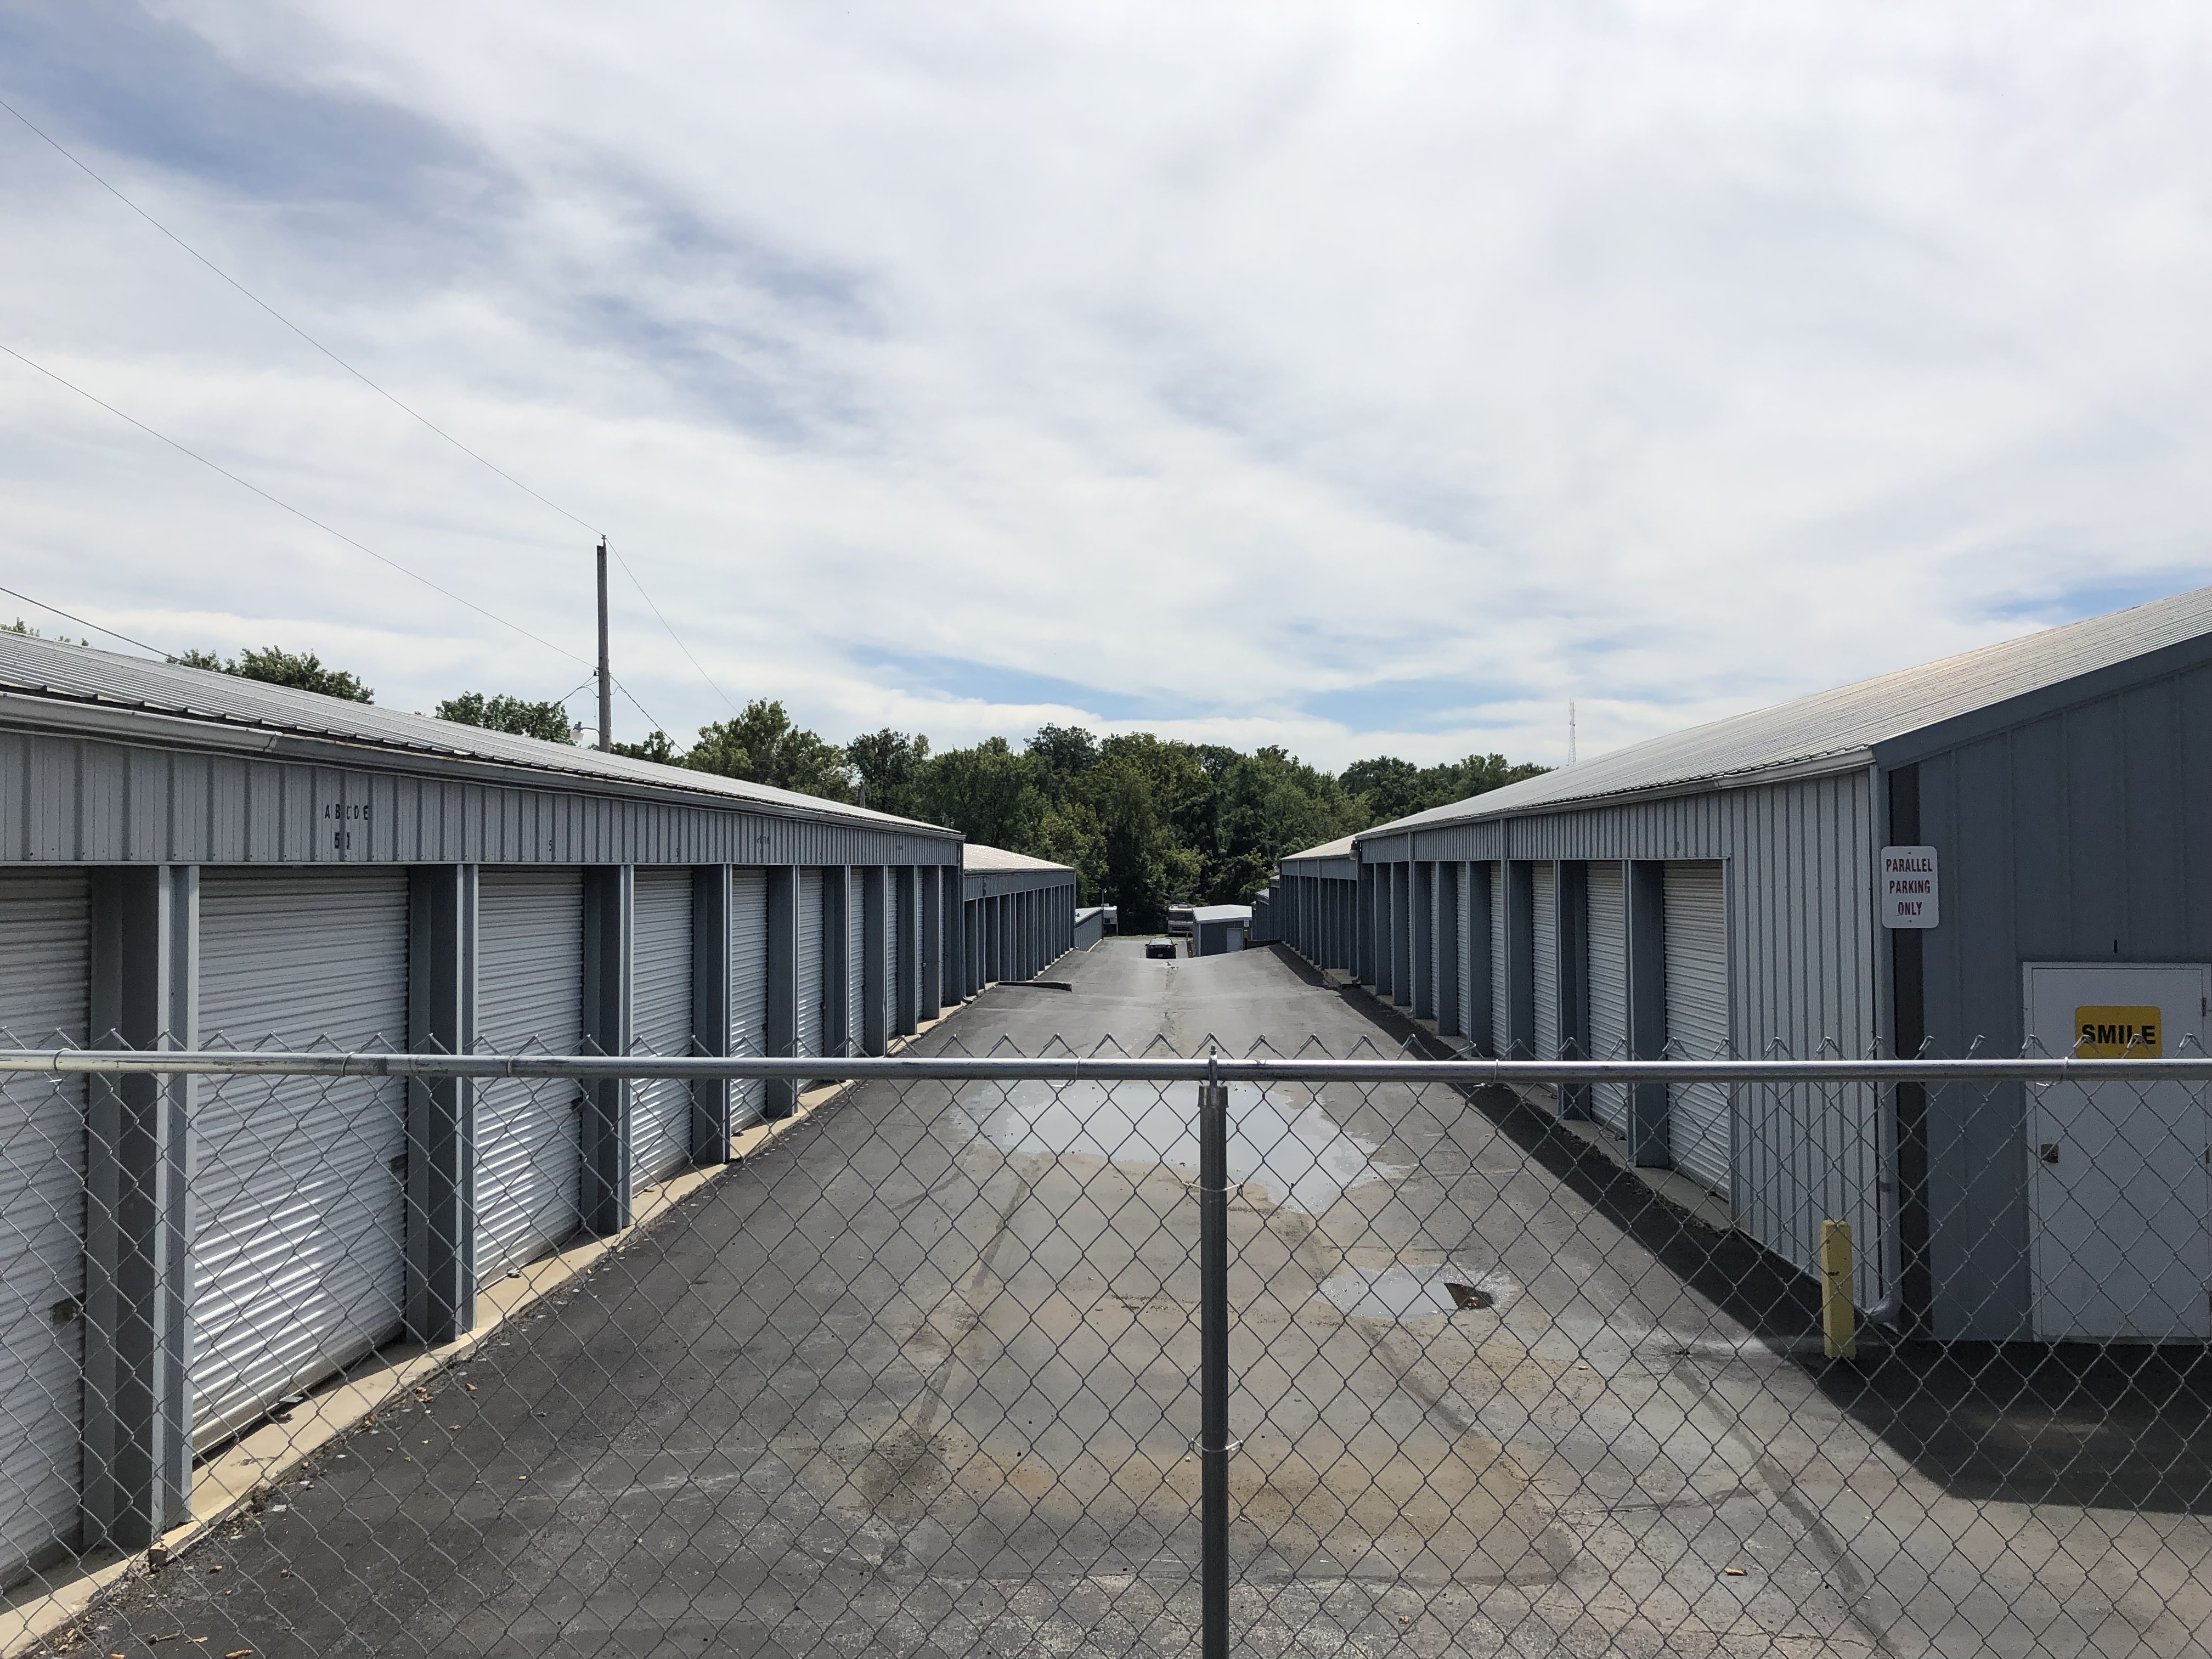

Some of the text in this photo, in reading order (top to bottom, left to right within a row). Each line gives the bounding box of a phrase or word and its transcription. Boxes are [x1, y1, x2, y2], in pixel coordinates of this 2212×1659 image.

[1886, 858, 1933, 872] PARALLEL
[1889, 879, 1931, 894] PARKING
[1897, 901, 1922, 916] ONLY
[2081, 1024, 2157, 1045] SMILE
